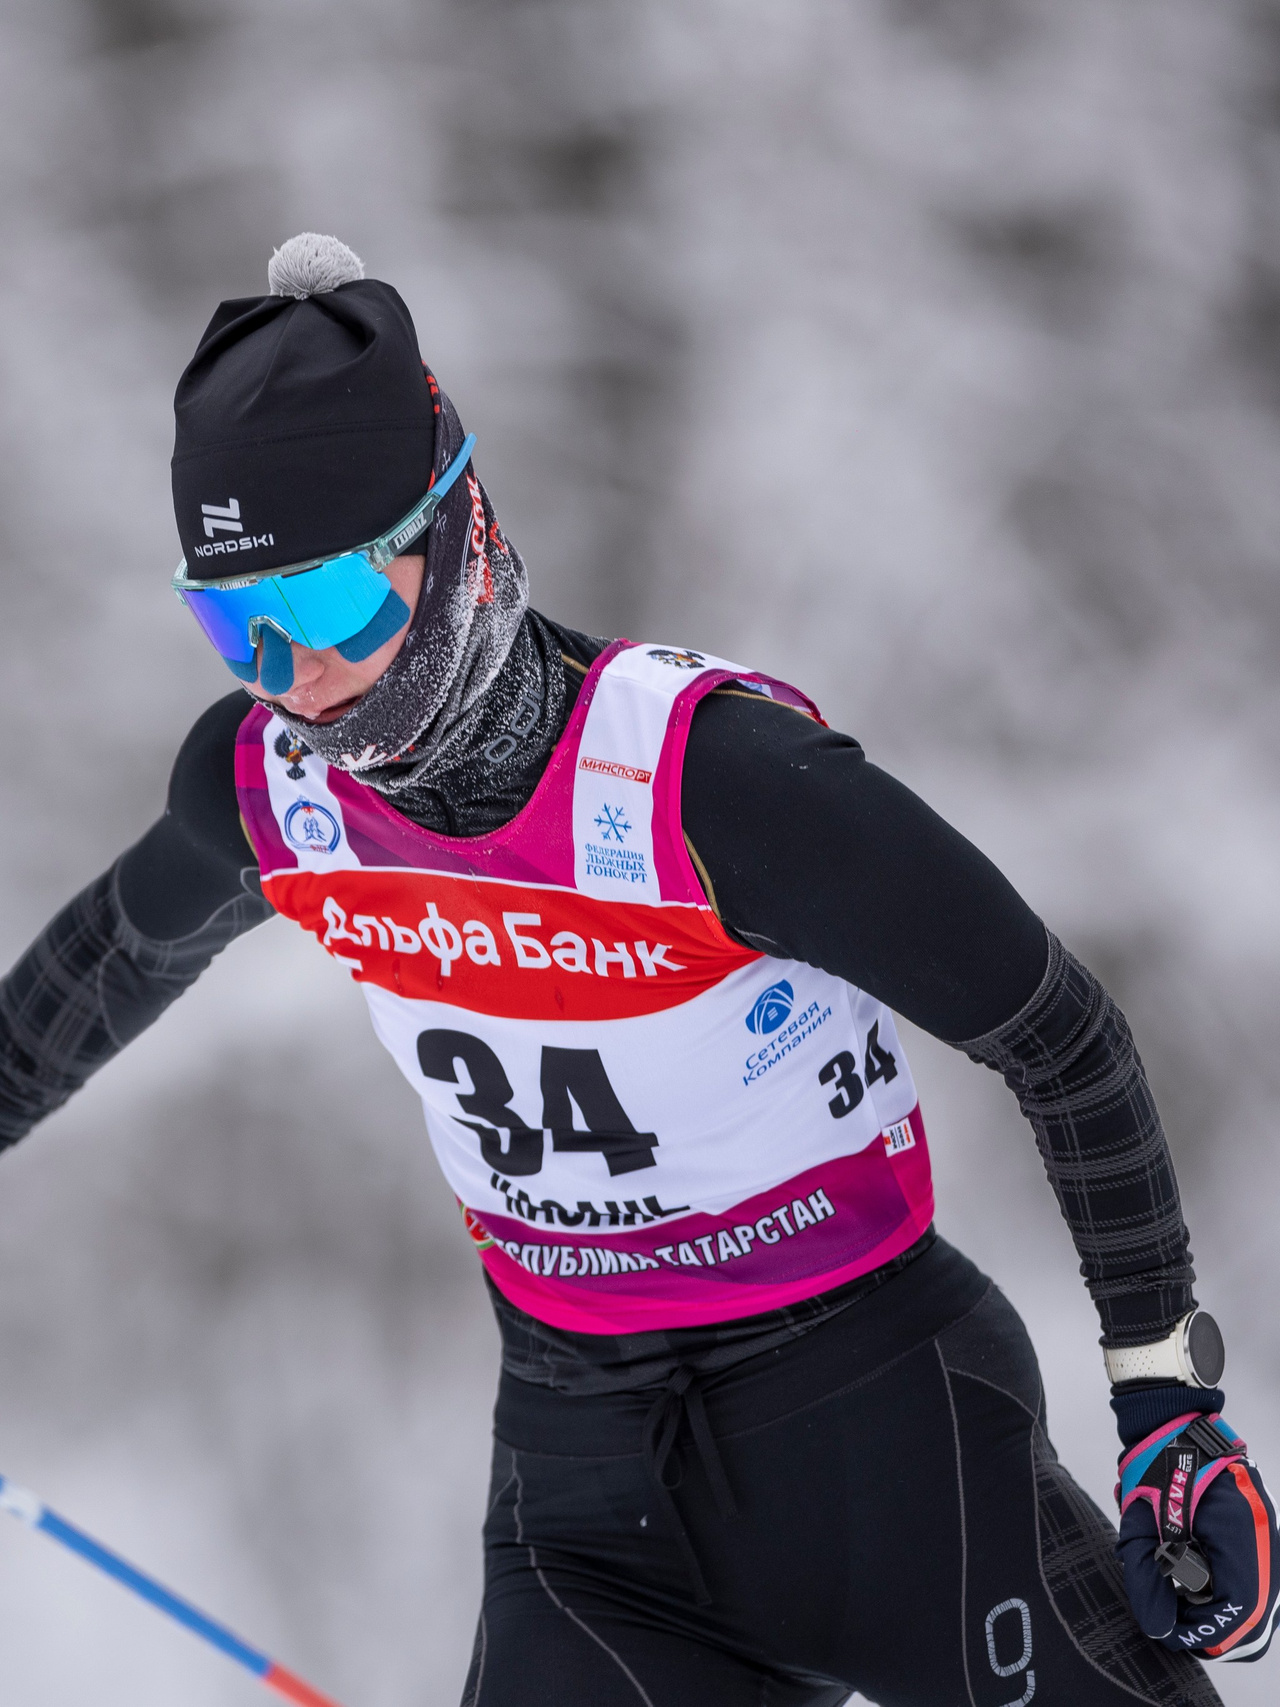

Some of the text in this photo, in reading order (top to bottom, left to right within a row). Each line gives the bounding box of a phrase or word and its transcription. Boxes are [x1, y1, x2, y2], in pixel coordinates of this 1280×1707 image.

[194, 533, 275, 558] NORDSKI
[581, 758, 651, 784] МИНСПОРТ
[584, 843, 645, 861] ФЕДЕРАЦИЯ
[585, 853, 646, 872] ЛЫЖНЫХ
[586, 865, 648, 883] ГОНОК РТ
[322, 896, 688, 978] Альфа Банк
[745, 1001, 820, 1070] Сетевая
[818, 1018, 898, 1119] 34
[417, 1028, 660, 1177] 34
[654, 1187, 836, 1268] ТАТАРСТАН
[1165, 1522, 1182, 1535] LEFT
[1178, 1603, 1243, 1647] MOAX
